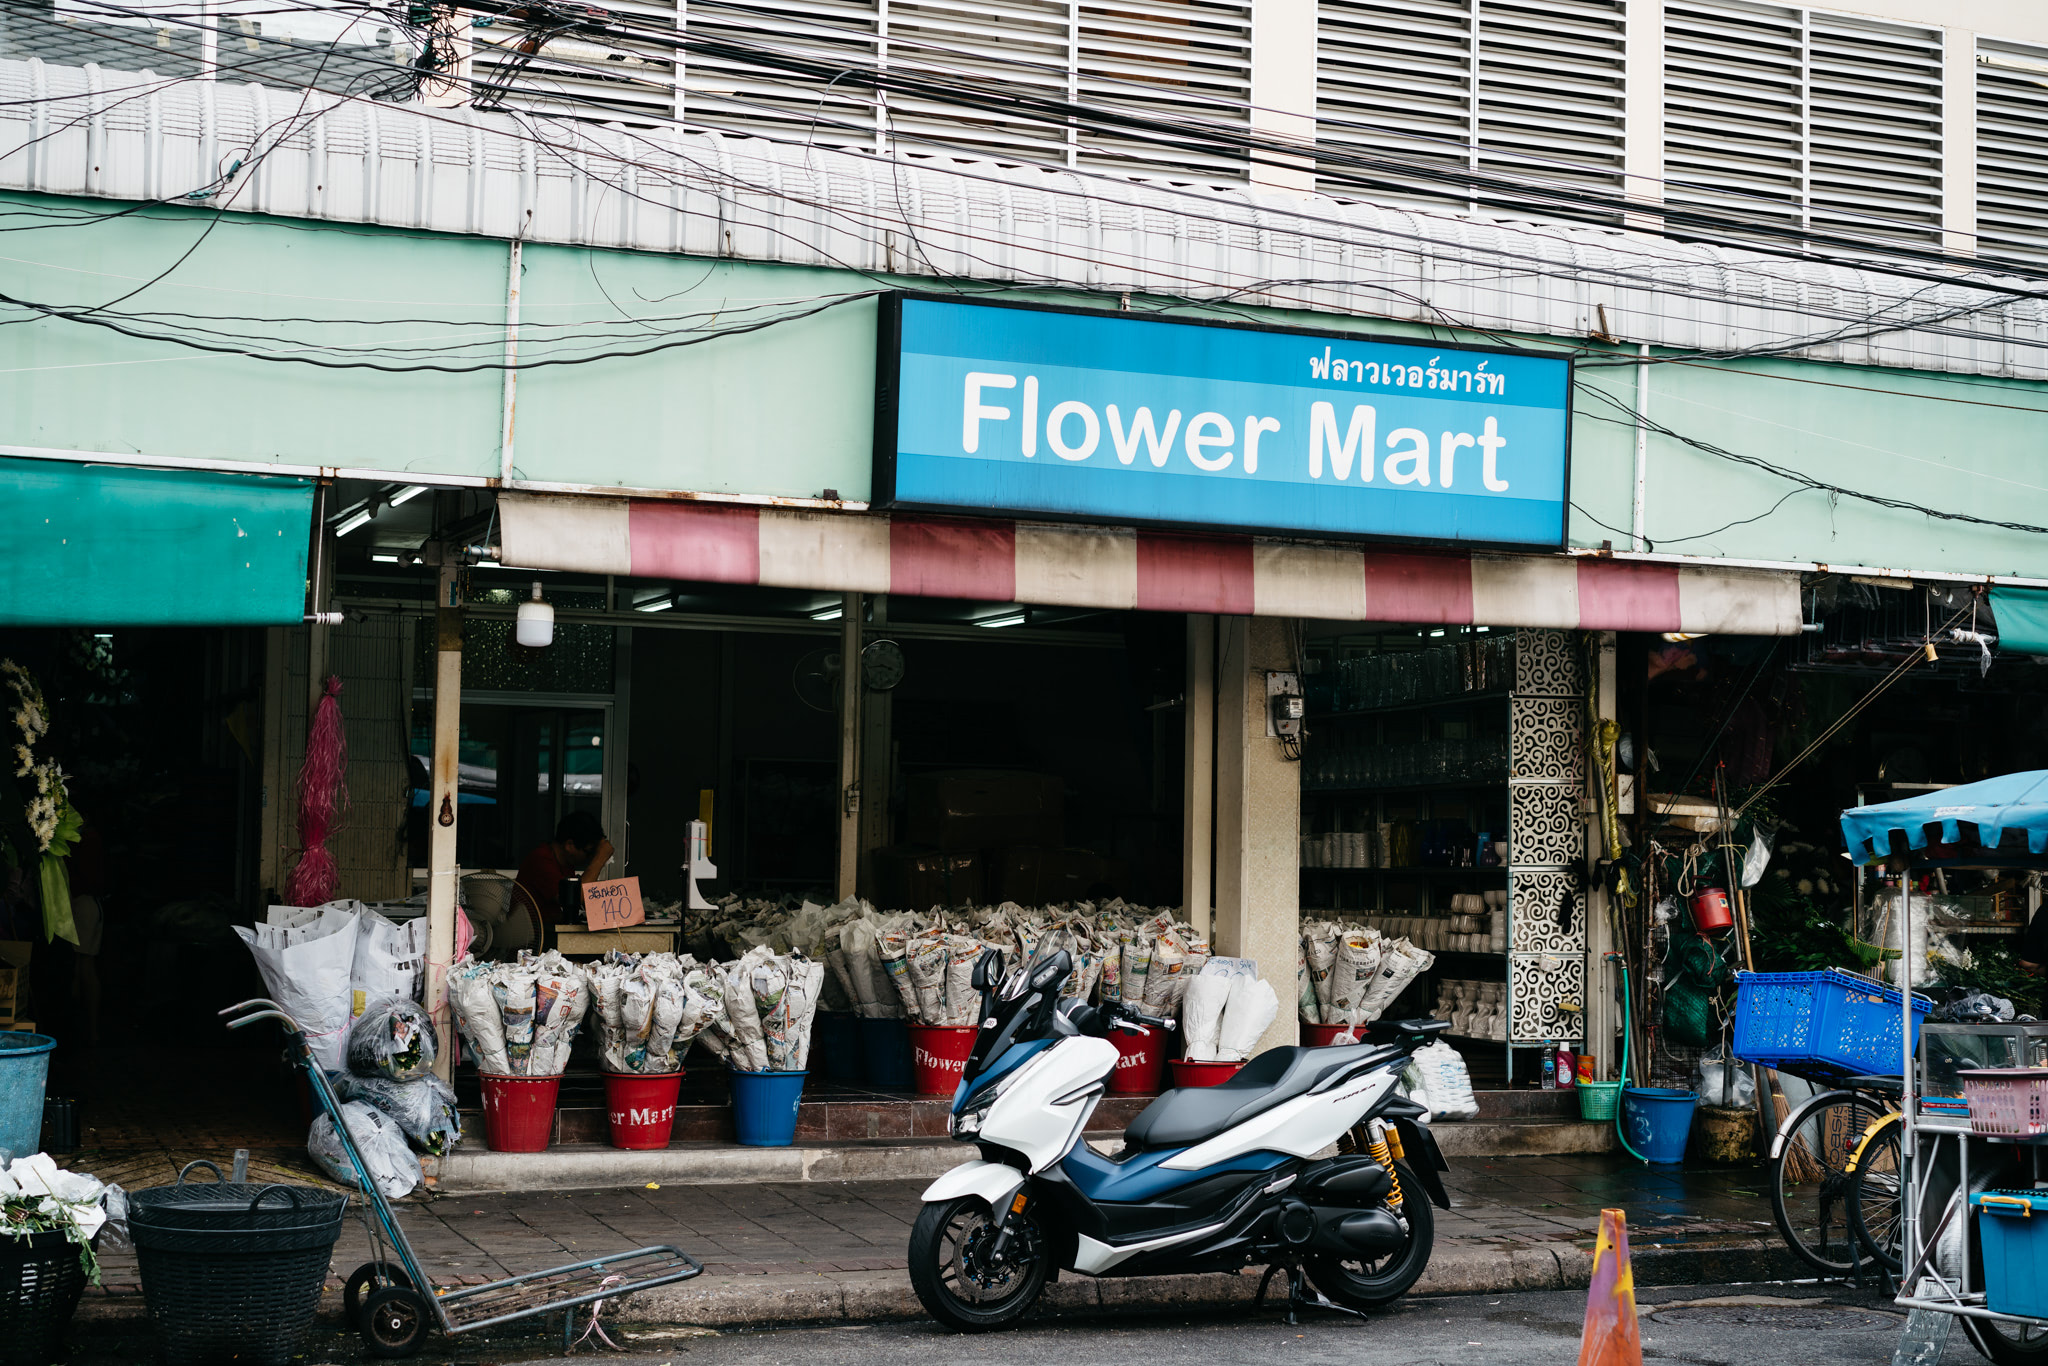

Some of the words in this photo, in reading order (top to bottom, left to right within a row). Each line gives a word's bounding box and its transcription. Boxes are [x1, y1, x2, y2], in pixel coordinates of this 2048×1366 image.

[1309, 346, 1505, 395] ฟลาวเวอร์มาร์ท
[961, 371, 1281, 475] Flower
[1308, 401, 1510, 493] Mart
[601, 896, 633, 923] 140
[629, 1104, 674, 1126] Mart
